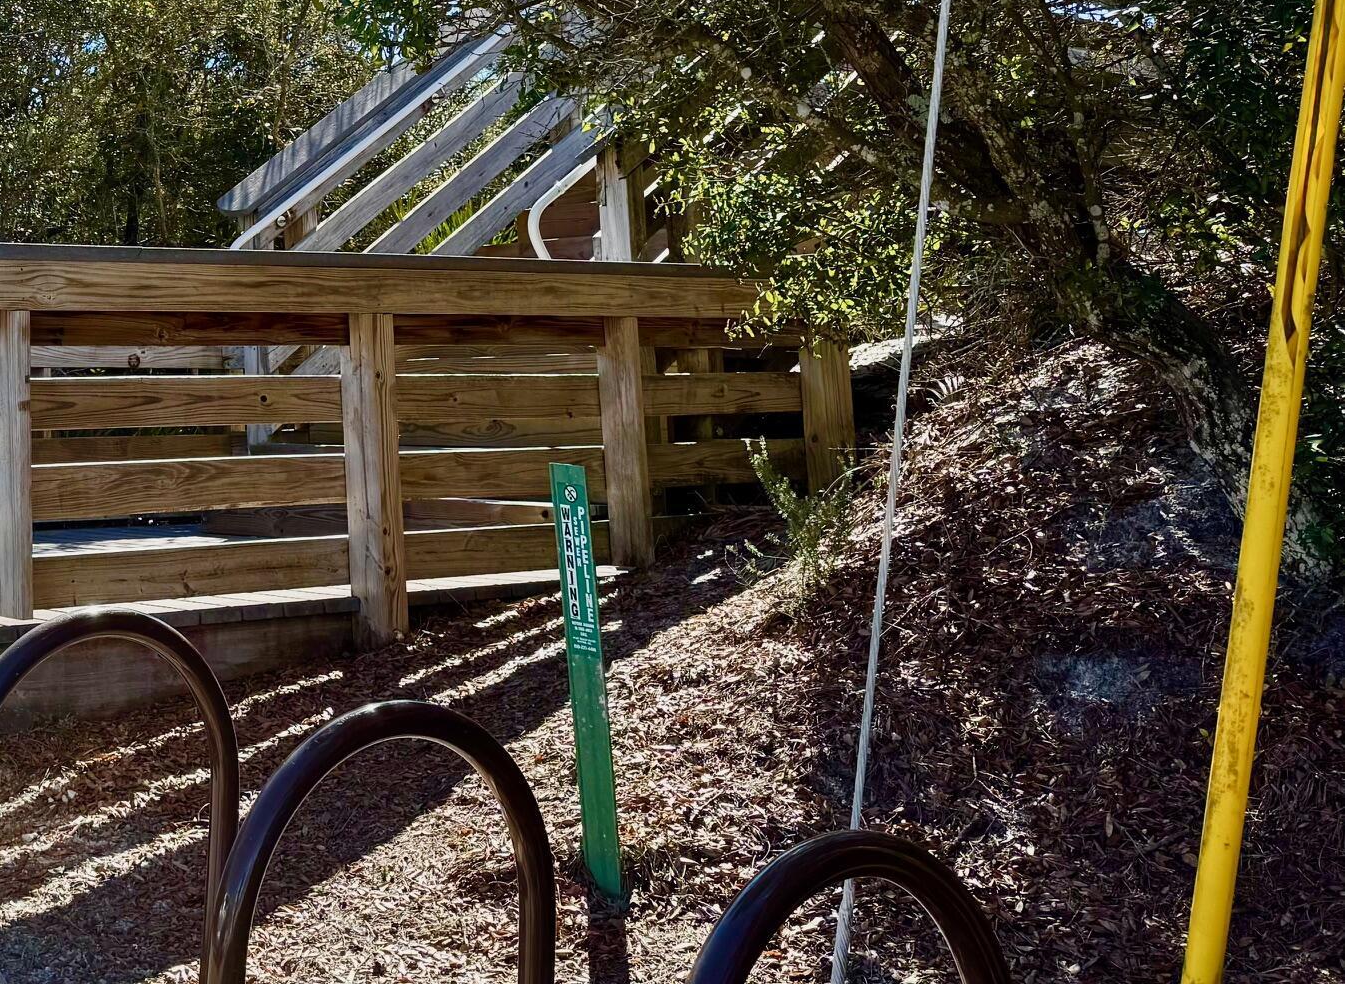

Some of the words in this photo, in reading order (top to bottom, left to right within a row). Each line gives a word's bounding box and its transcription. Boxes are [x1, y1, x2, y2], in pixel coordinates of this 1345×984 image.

[561, 507, 579, 617] WARNING
[573, 516, 582, 567] SEWER
[577, 506, 594, 623] PIPELINE
